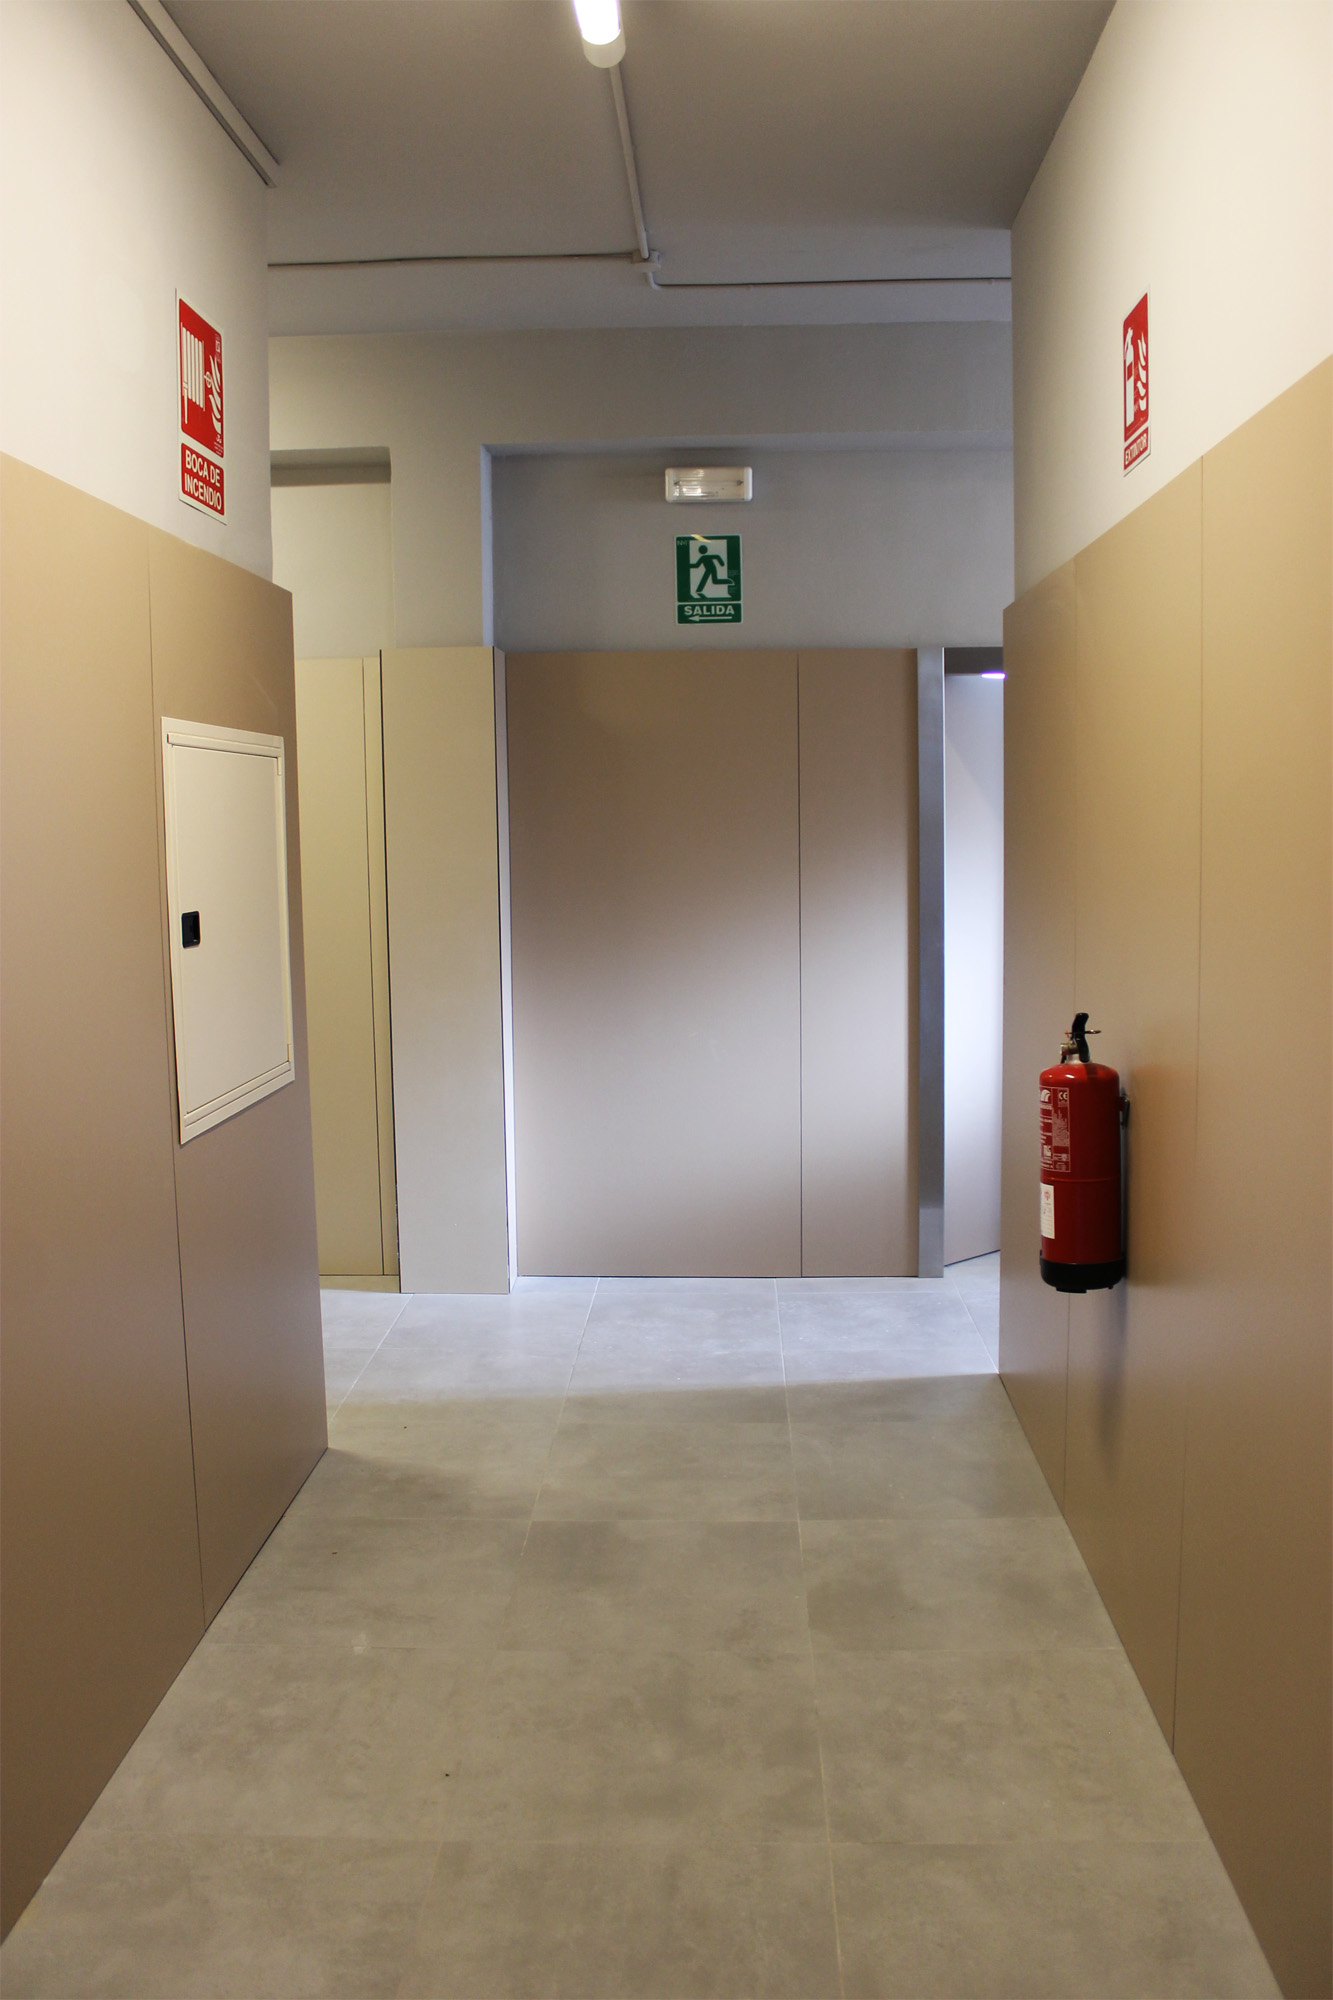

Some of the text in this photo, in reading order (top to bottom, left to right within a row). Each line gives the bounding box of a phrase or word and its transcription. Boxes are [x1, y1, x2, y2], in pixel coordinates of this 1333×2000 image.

[185, 449, 221, 487] BOCA DE
[184, 472, 222, 510] INCENDIO
[684, 605, 735, 615] SALIDA
